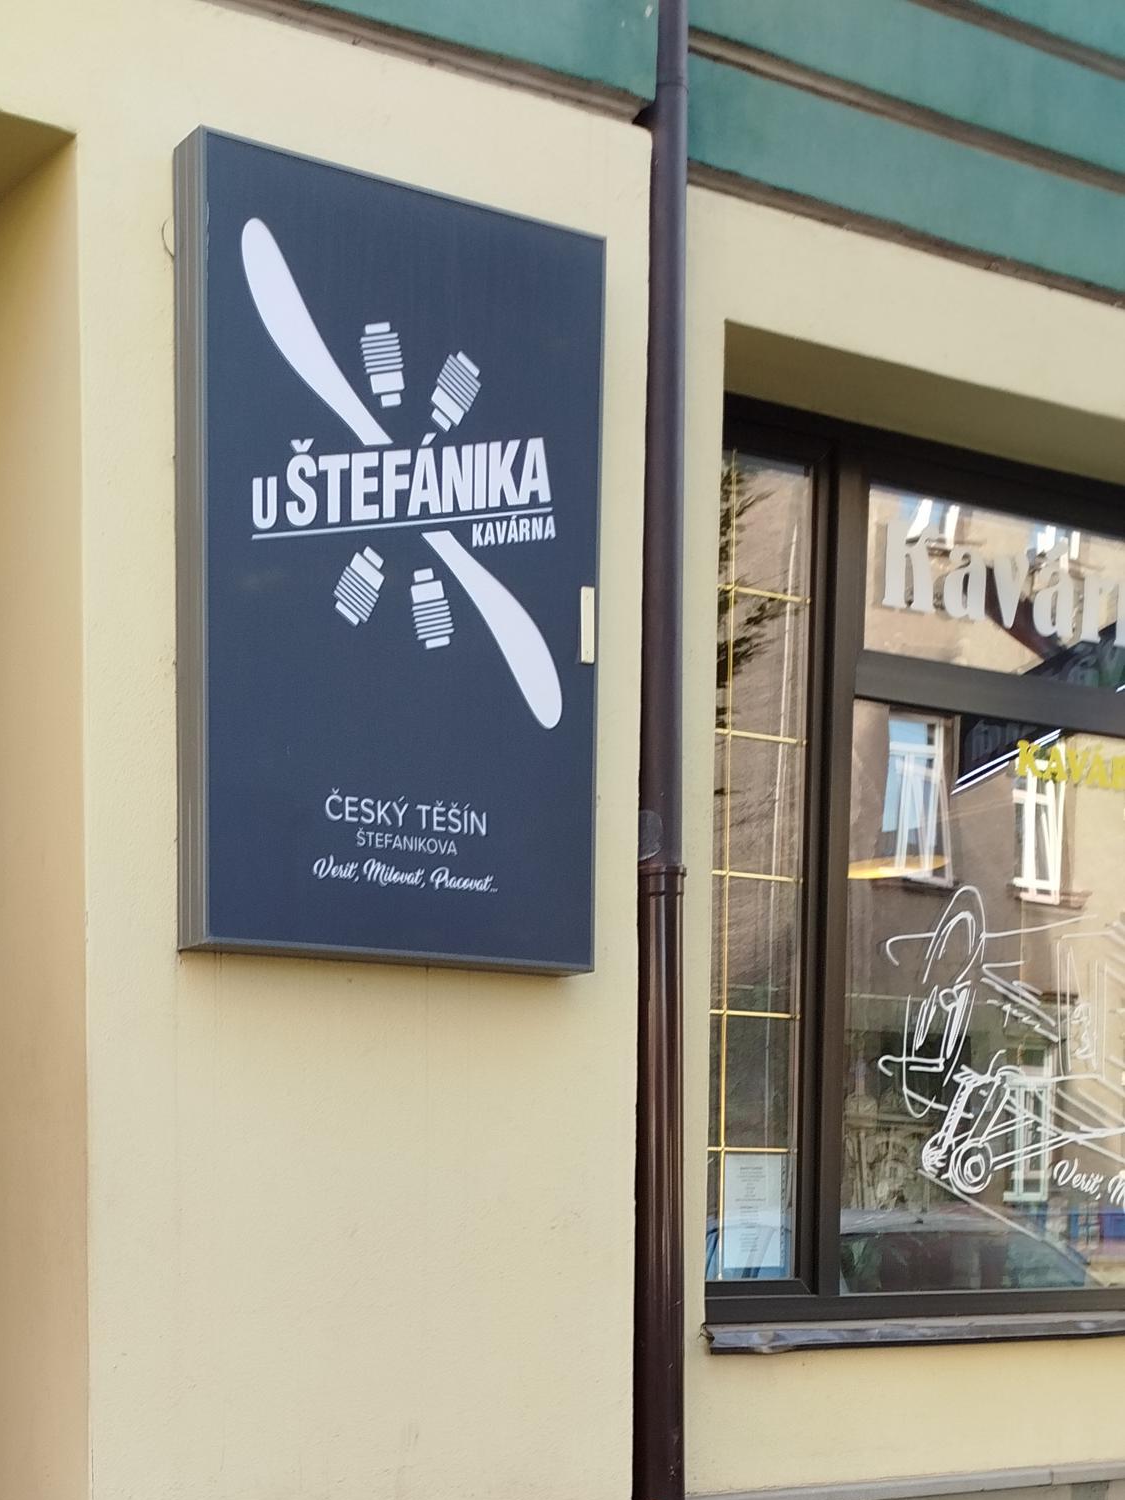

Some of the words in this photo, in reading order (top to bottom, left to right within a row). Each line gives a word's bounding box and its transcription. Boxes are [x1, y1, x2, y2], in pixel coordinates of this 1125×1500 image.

[285, 432, 552, 526] ŠTEFÁNIKA
[472, 514, 556, 548] KAVÁRNA
[325, 787, 409, 827] ČESKÝ
[416, 800, 487, 836] TĚŠÍN
[356, 827, 458, 856] ŠTEFANIKOVA
